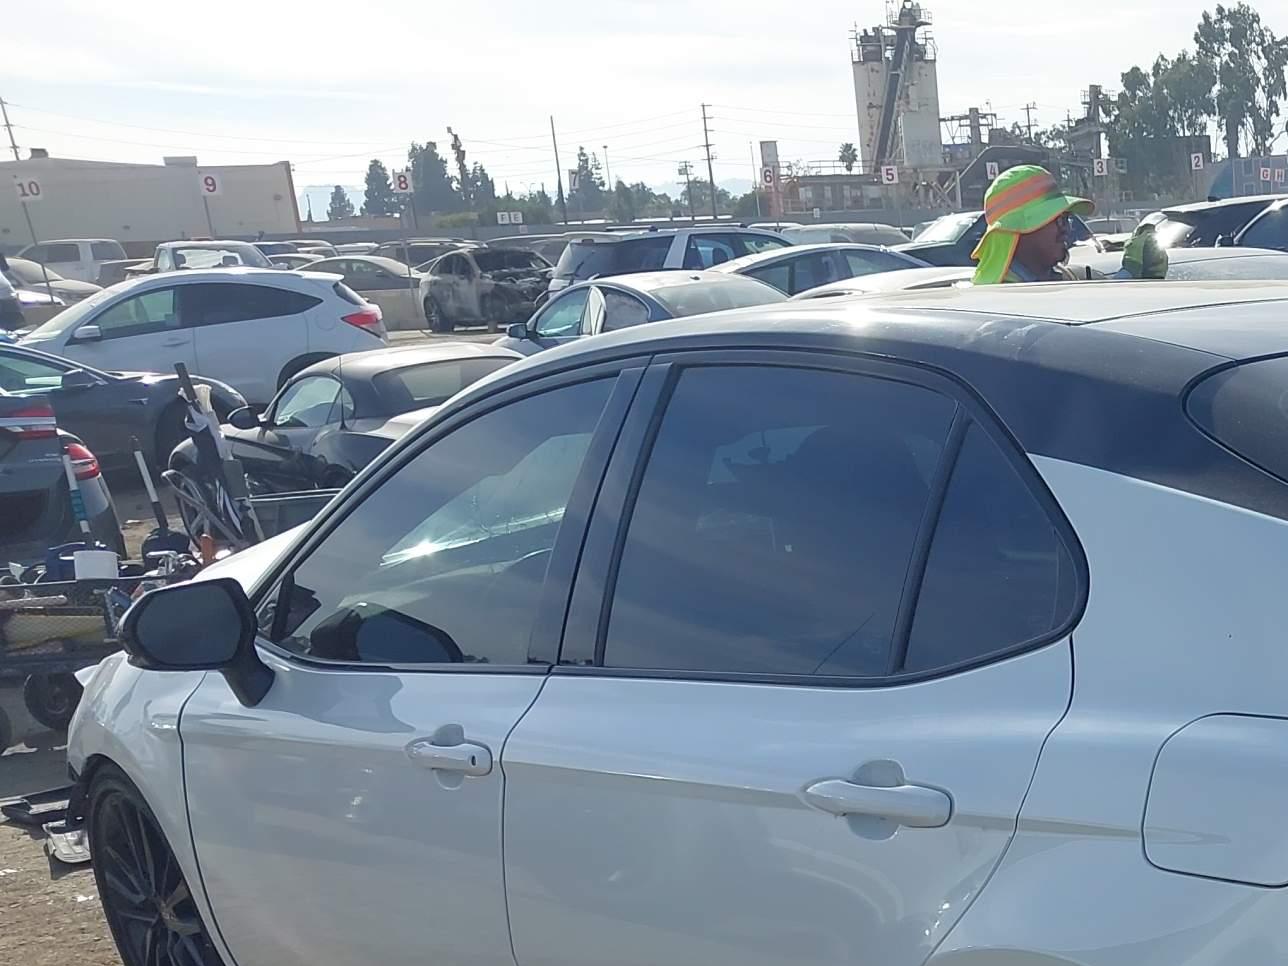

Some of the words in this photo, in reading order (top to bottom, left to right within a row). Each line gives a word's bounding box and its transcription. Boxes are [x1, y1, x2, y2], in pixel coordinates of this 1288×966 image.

[1096, 160, 1104, 174] 3
[1193, 155, 1201, 168] 2
[763, 169, 773, 183] 6
[885, 168, 895, 181] 5
[989, 164, 997, 177] 4
[203, 176, 217, 193] 9
[397, 174, 409, 190] 8
[570, 171, 578, 187] 7
[17, 180, 41, 198] 10
